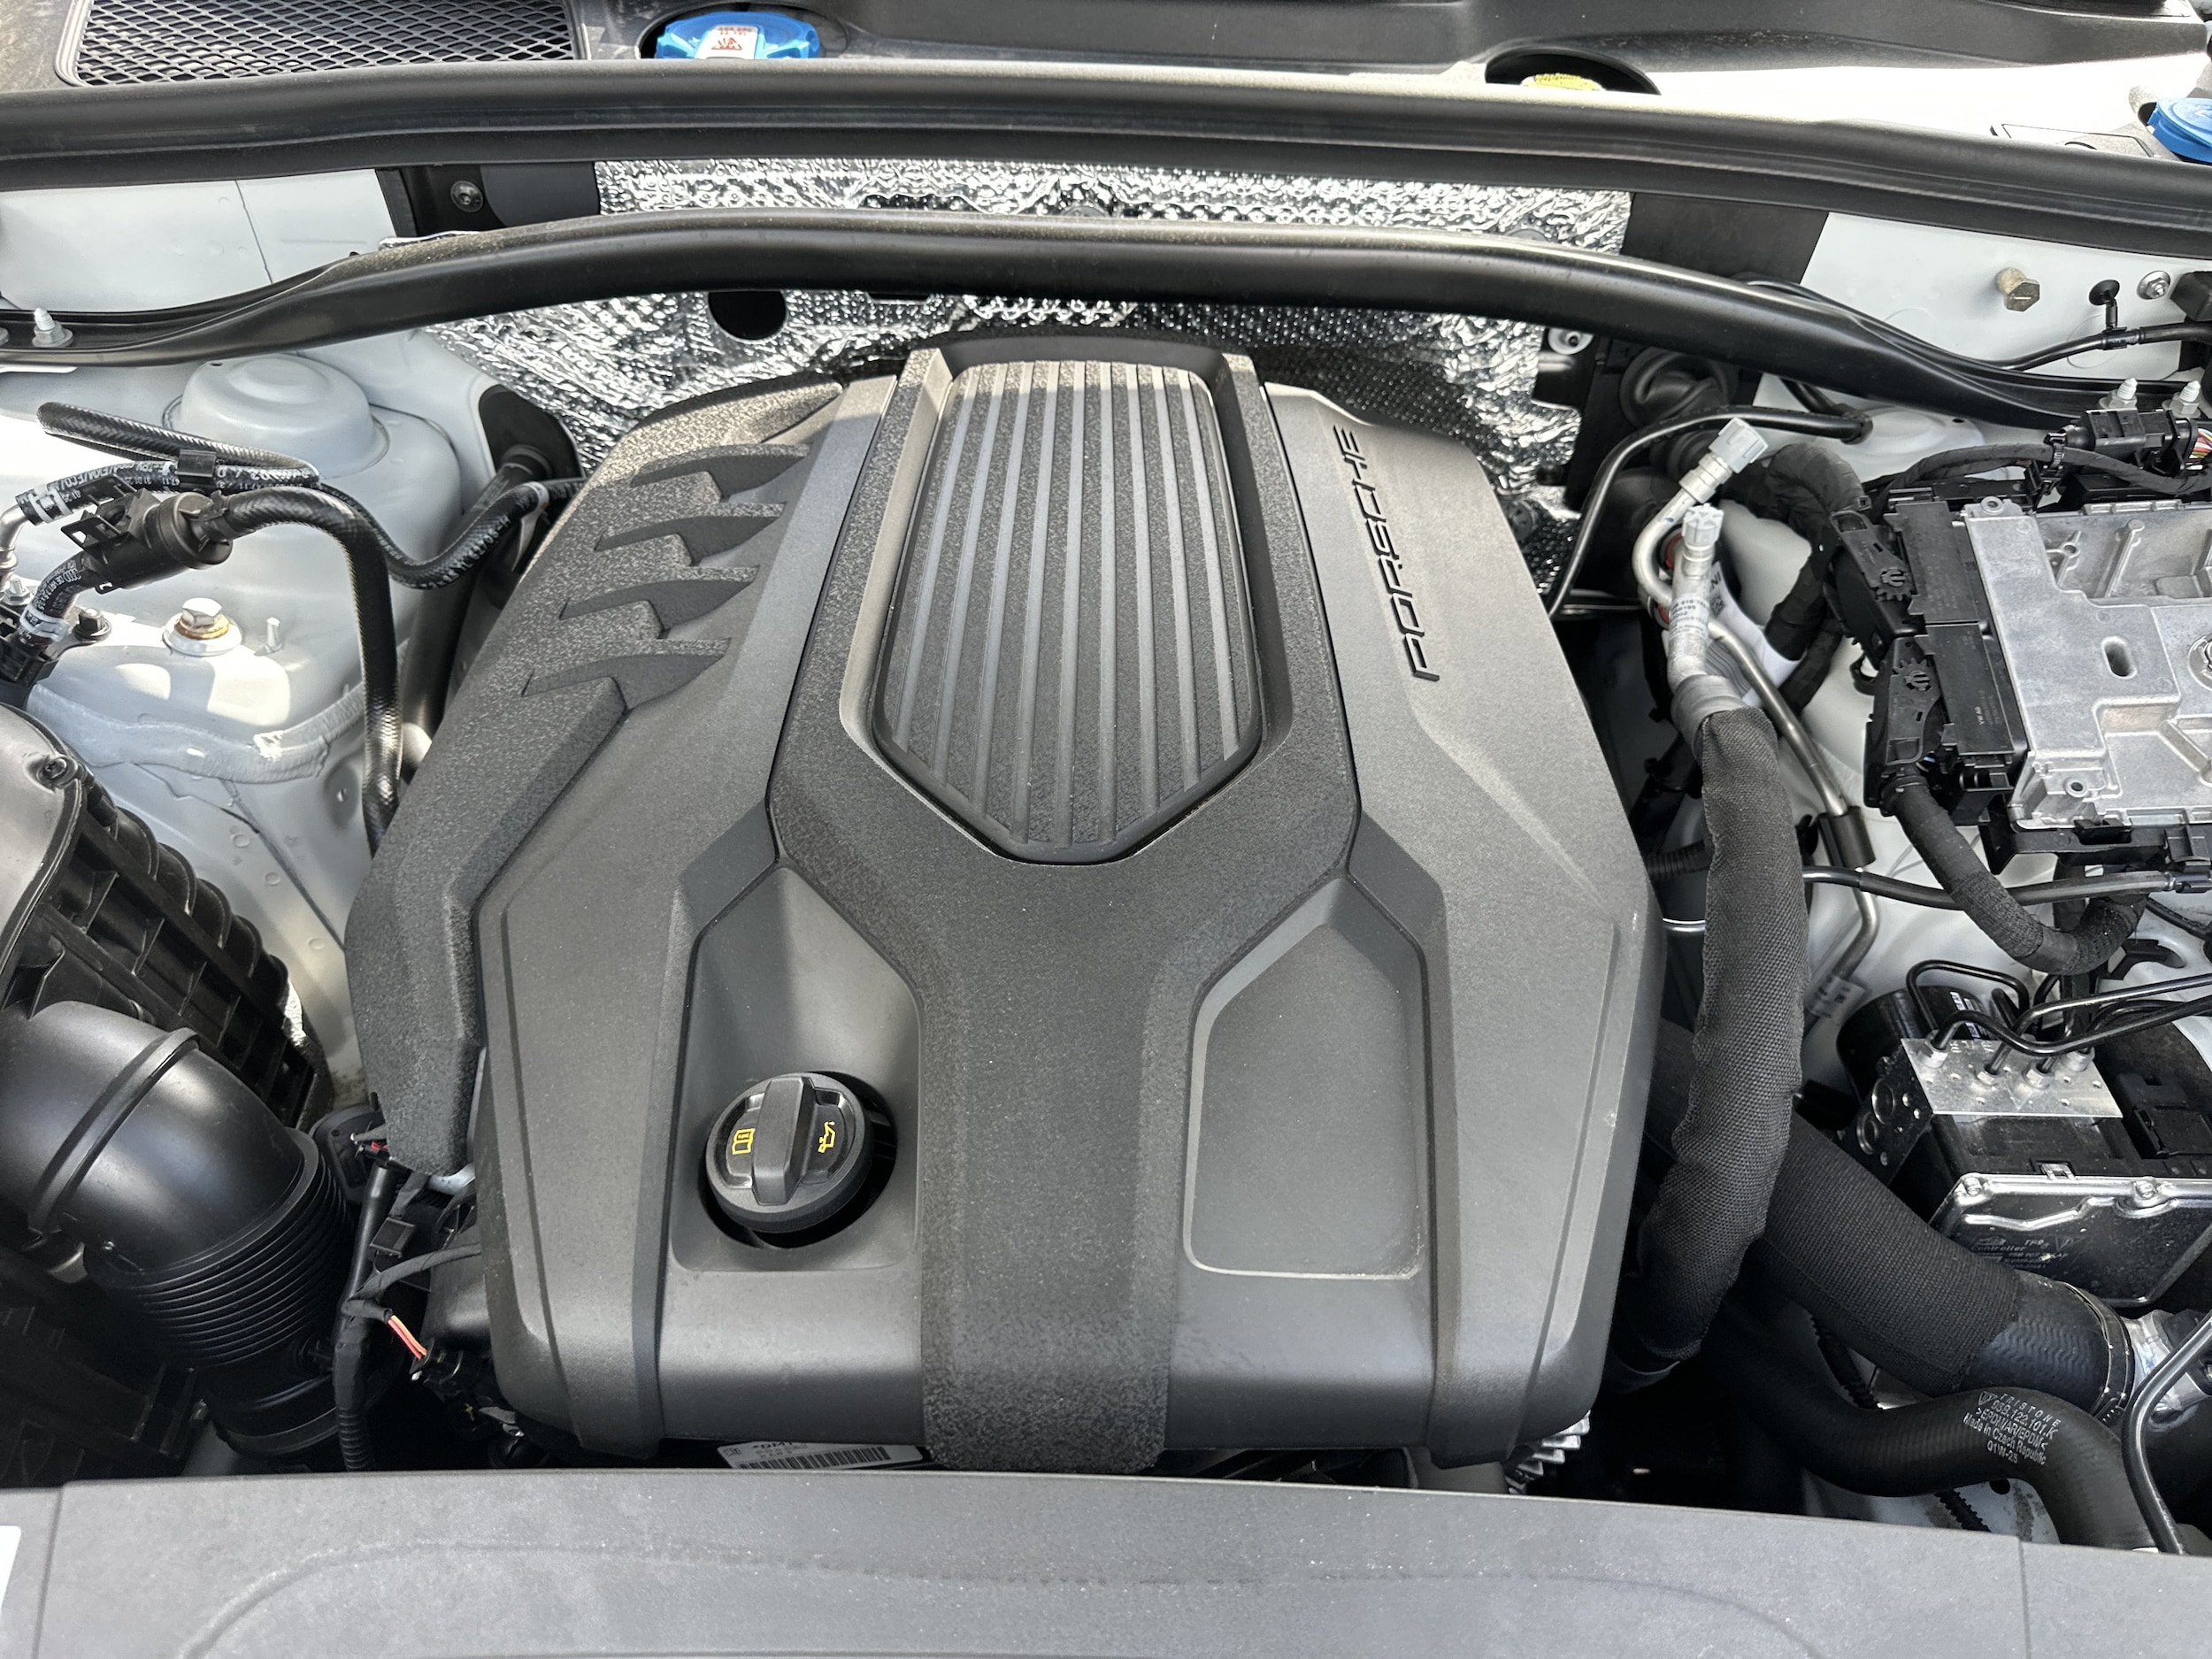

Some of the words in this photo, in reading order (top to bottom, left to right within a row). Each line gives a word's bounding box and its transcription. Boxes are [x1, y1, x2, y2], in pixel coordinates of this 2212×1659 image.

[1333, 425, 1440, 681] PORSCHE
[2000, 1393, 2062, 1427] TRISTONE
[1962, 1412, 1984, 1432] Made
[1992, 1427, 2016, 1449] Czech
[2016, 1440, 2047, 1465] Republic
